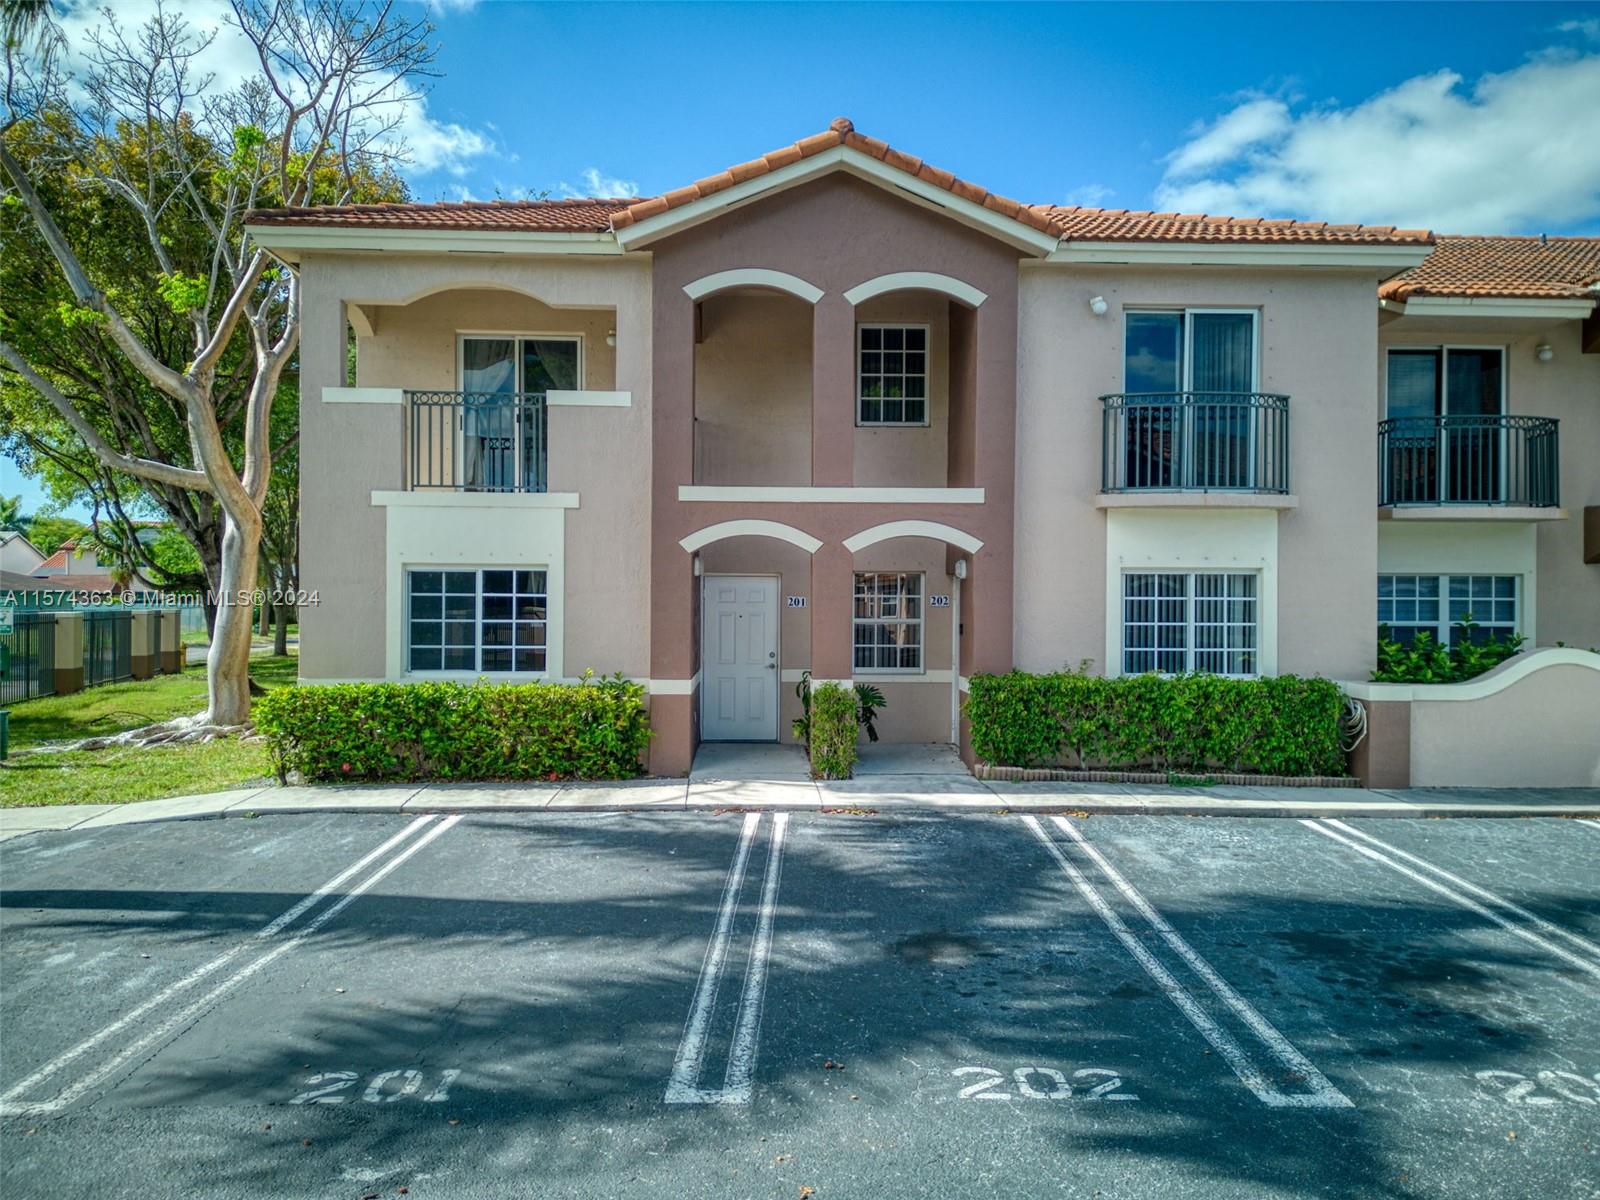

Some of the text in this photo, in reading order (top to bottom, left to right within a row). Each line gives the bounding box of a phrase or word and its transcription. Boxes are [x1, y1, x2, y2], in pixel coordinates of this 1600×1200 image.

[787, 596, 806, 607] 201
[930, 596, 949, 607] 202
[288, 1068, 462, 1104] 201
[951, 1066, 1140, 1101] 202
[1475, 1069, 1600, 1105] 20
